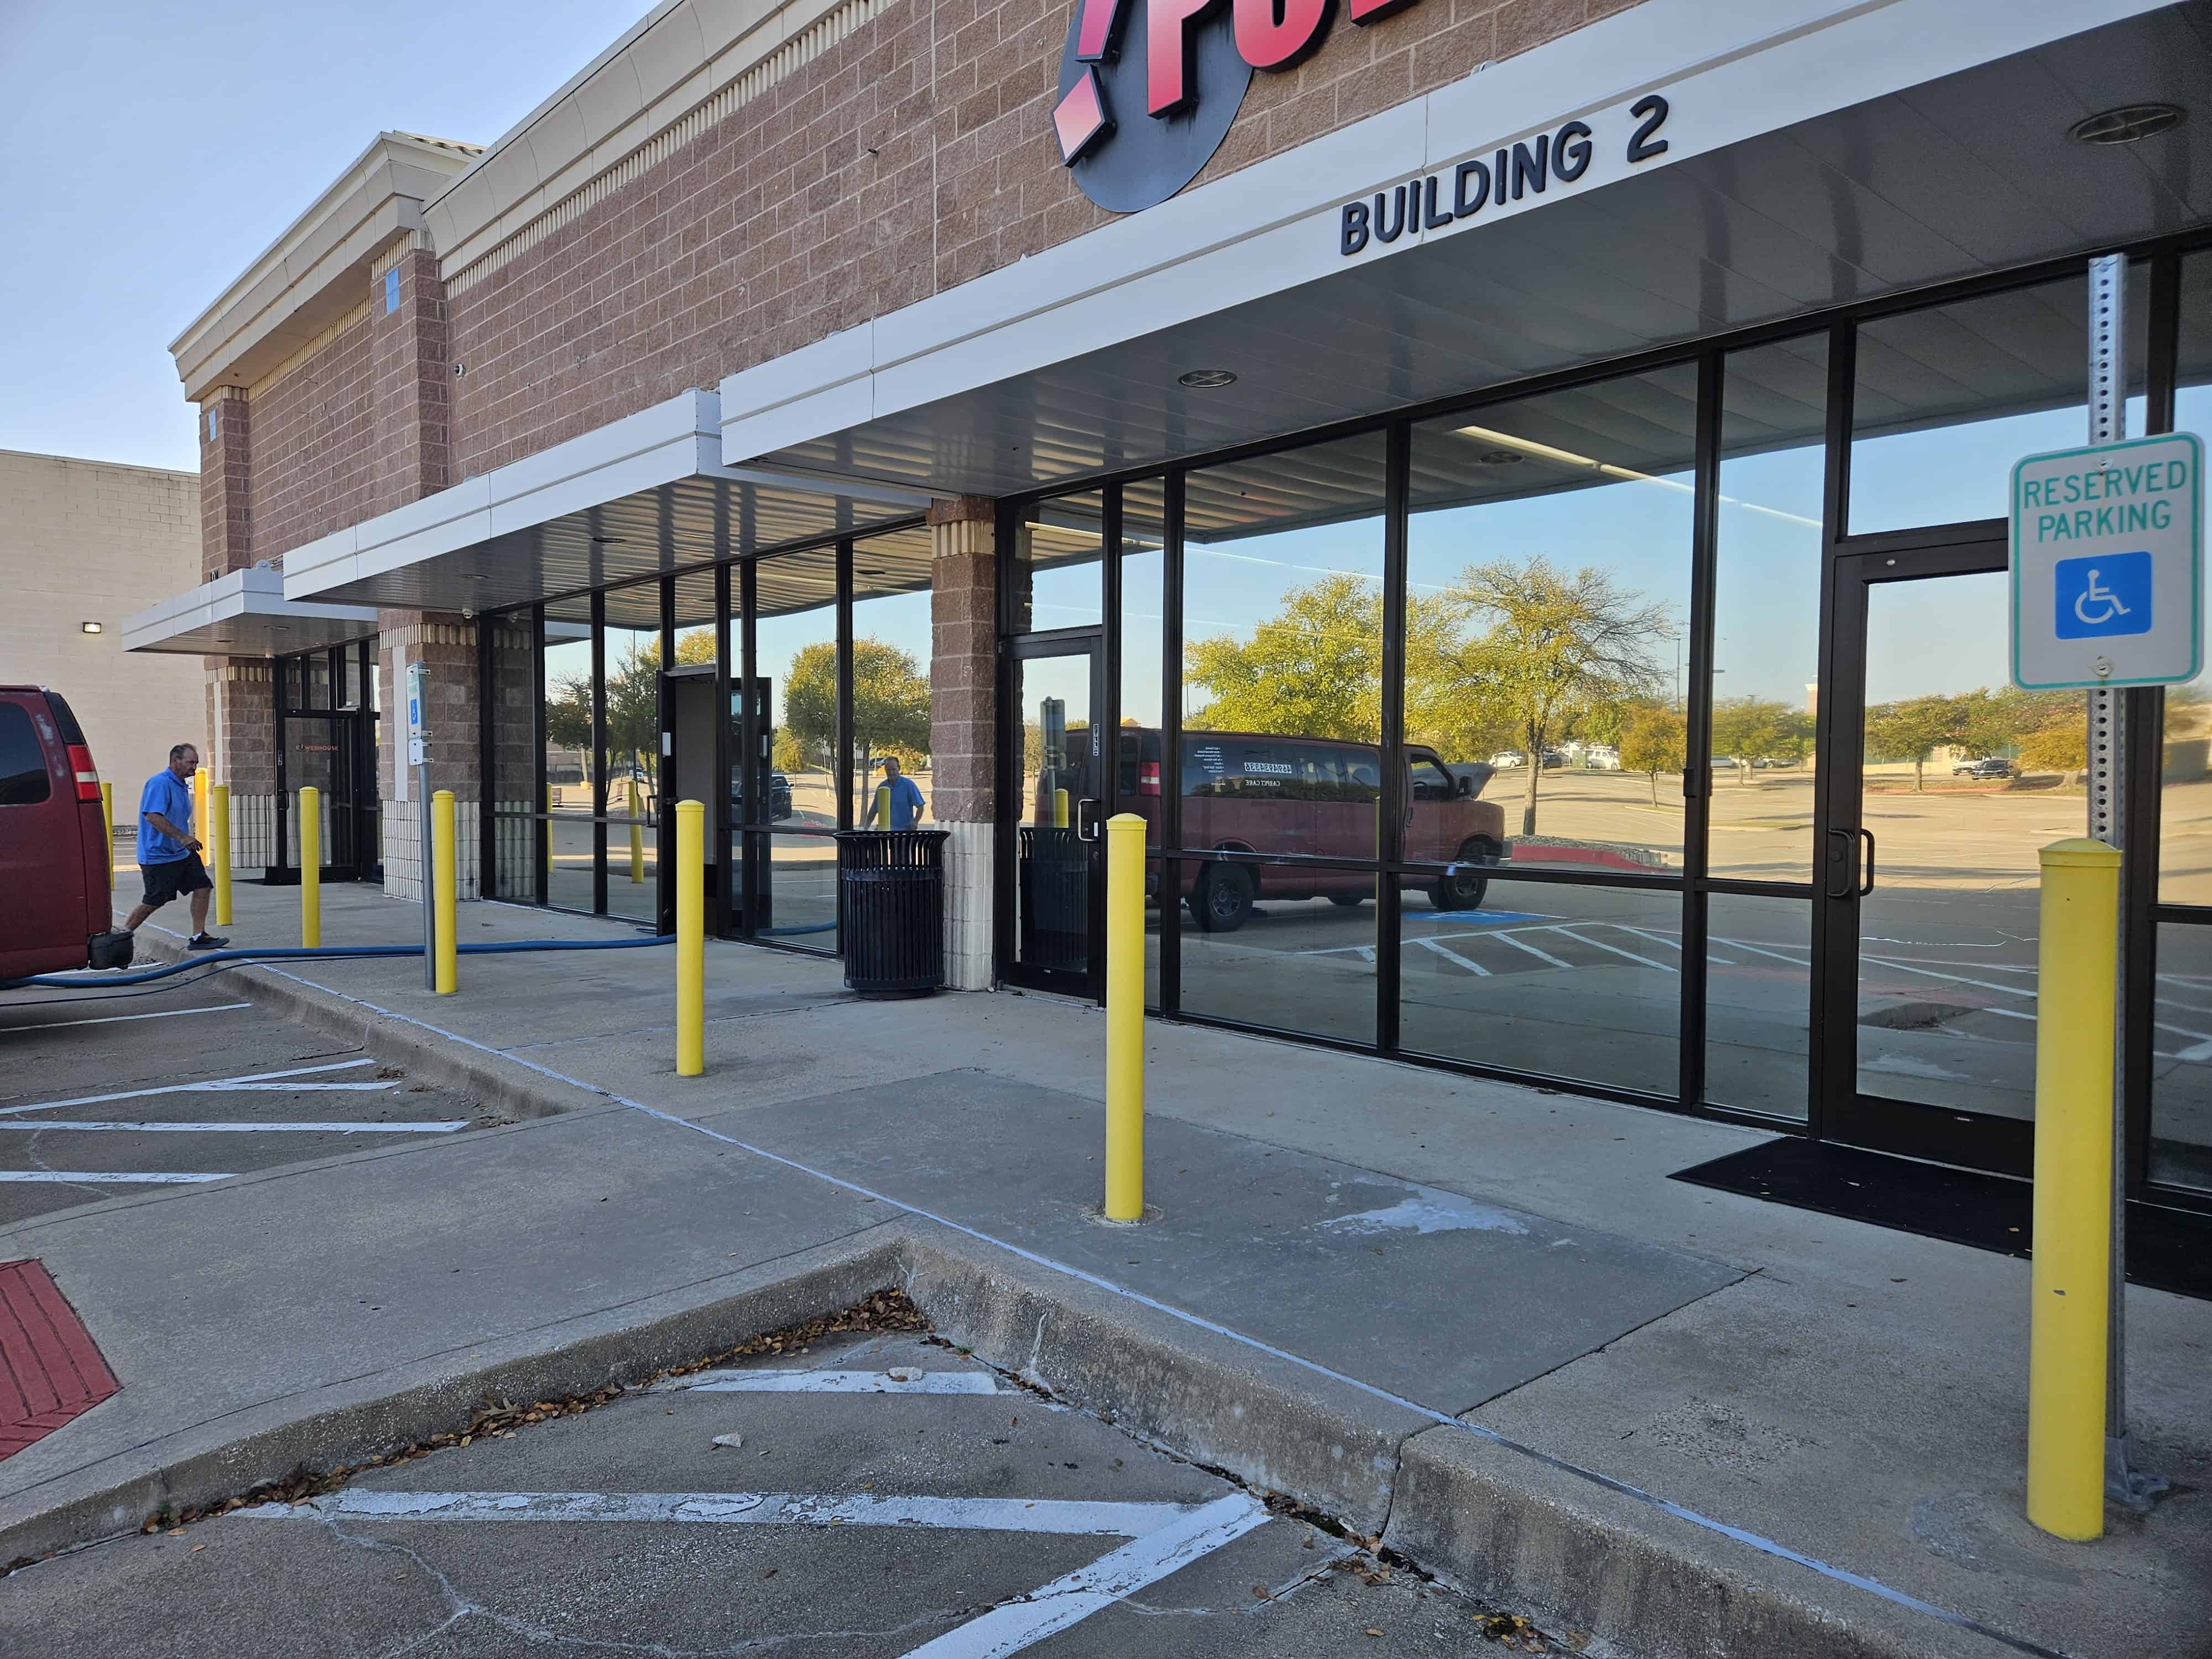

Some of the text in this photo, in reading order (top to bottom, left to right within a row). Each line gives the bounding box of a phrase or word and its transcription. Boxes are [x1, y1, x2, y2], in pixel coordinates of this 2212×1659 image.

[1340, 95, 1670, 255] BUILDING 2
[2023, 460, 2187, 509] RESERVED
[2038, 499, 2171, 543] PARKING
